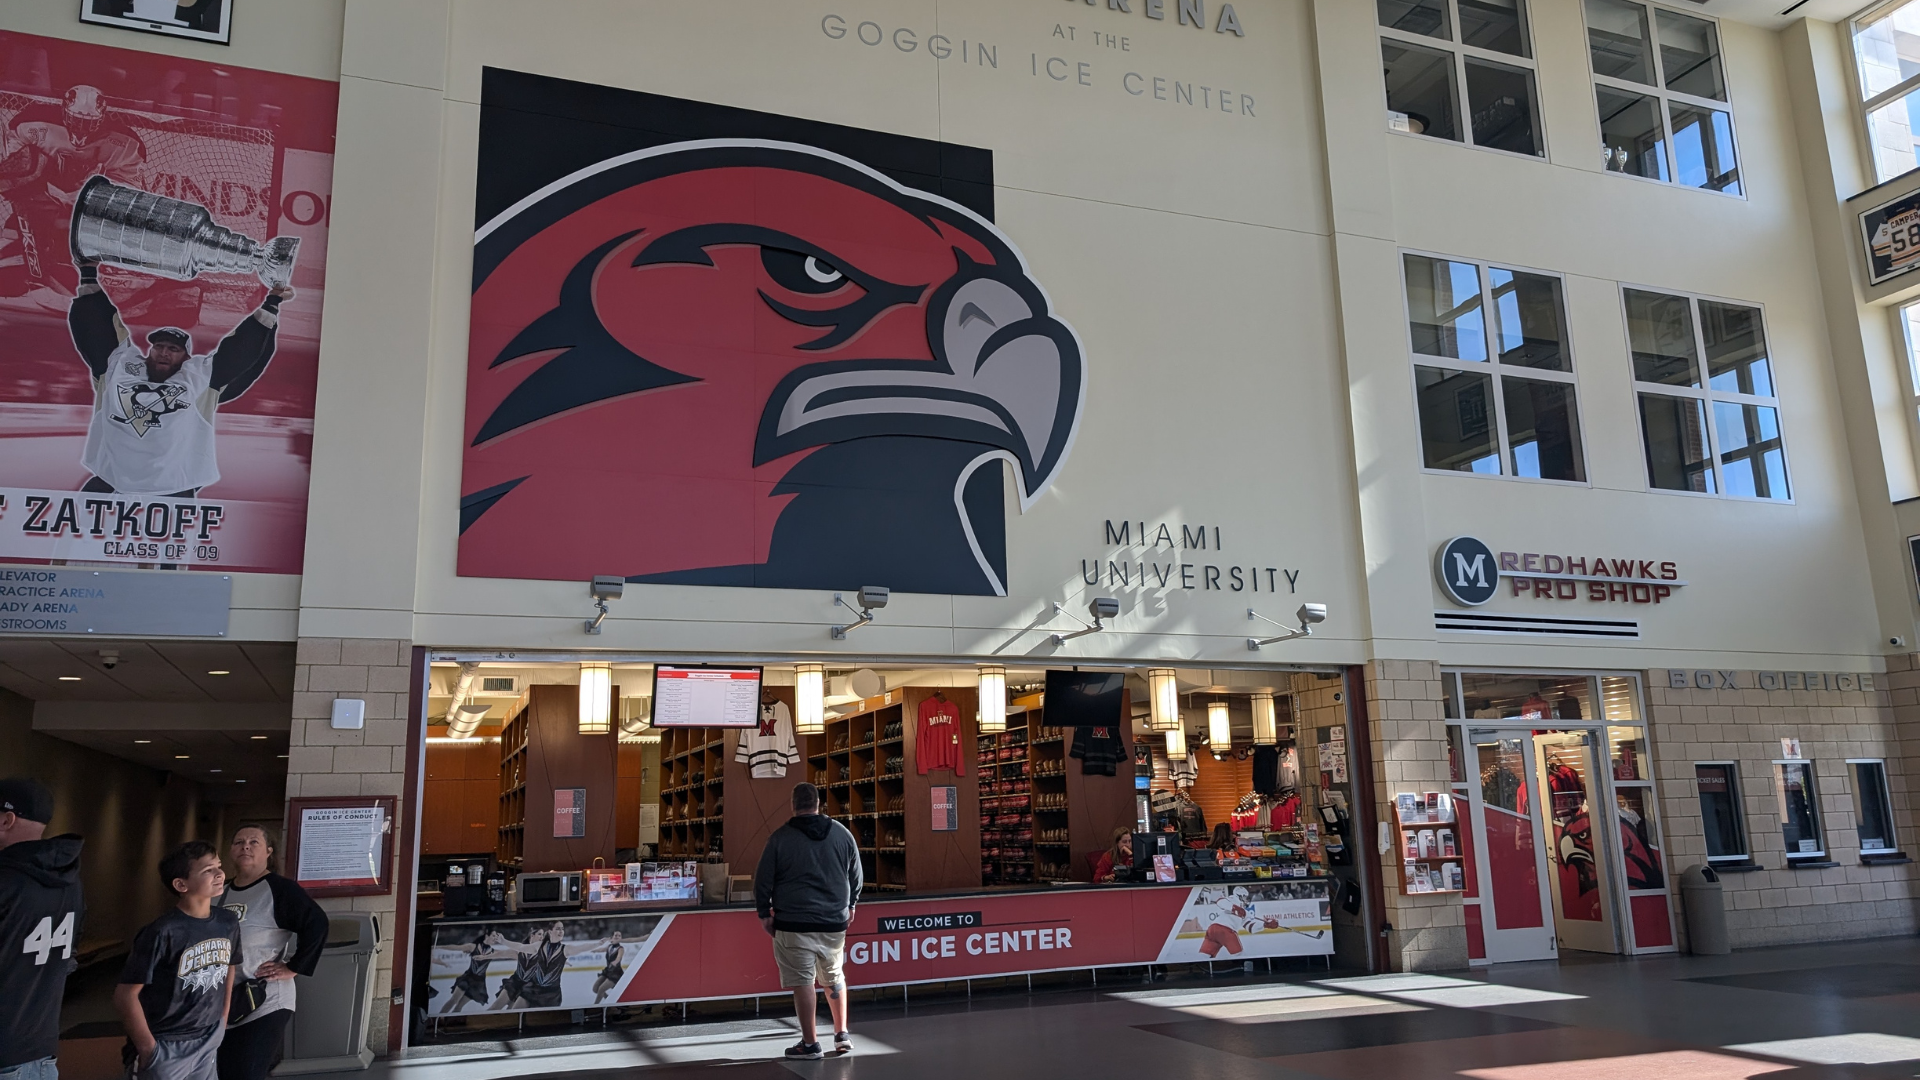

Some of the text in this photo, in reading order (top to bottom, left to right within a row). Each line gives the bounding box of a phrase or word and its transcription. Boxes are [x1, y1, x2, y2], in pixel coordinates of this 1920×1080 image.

[1065, 0, 1245, 38] ENA
[1052, 22, 1131, 53] AT THE
[820, 13, 1257, 118] GOGGIN ICE CENTER
[1891, 223, 1920, 253] 58
[22, 495, 226, 541] ZATKOFF
[1105, 519, 1221, 550] MIAMI
[103, 541, 219, 560] CLASS OF '09
[1082, 558, 1300, 594] UNIVERSITY
[1452, 551, 1678, 588] M REDHAWKS
[59, 588, 105, 599] ARENA
[1512, 577, 1671, 604] PRO SHOP
[32, 603, 78, 614] ARENA
[0, 619, 67, 630] STROOMS
[1669, 669, 1875, 692] BOX OFFICE
[759, 719, 777, 737] M
[884, 913, 974, 931] WELCOME TO
[1283, 912, 1315, 920] ATHLETICS
[23, 911, 75, 966] 44
[194, 940, 227, 955] NEWARK
[843, 927, 1073, 965] GIN ICE CENTER
